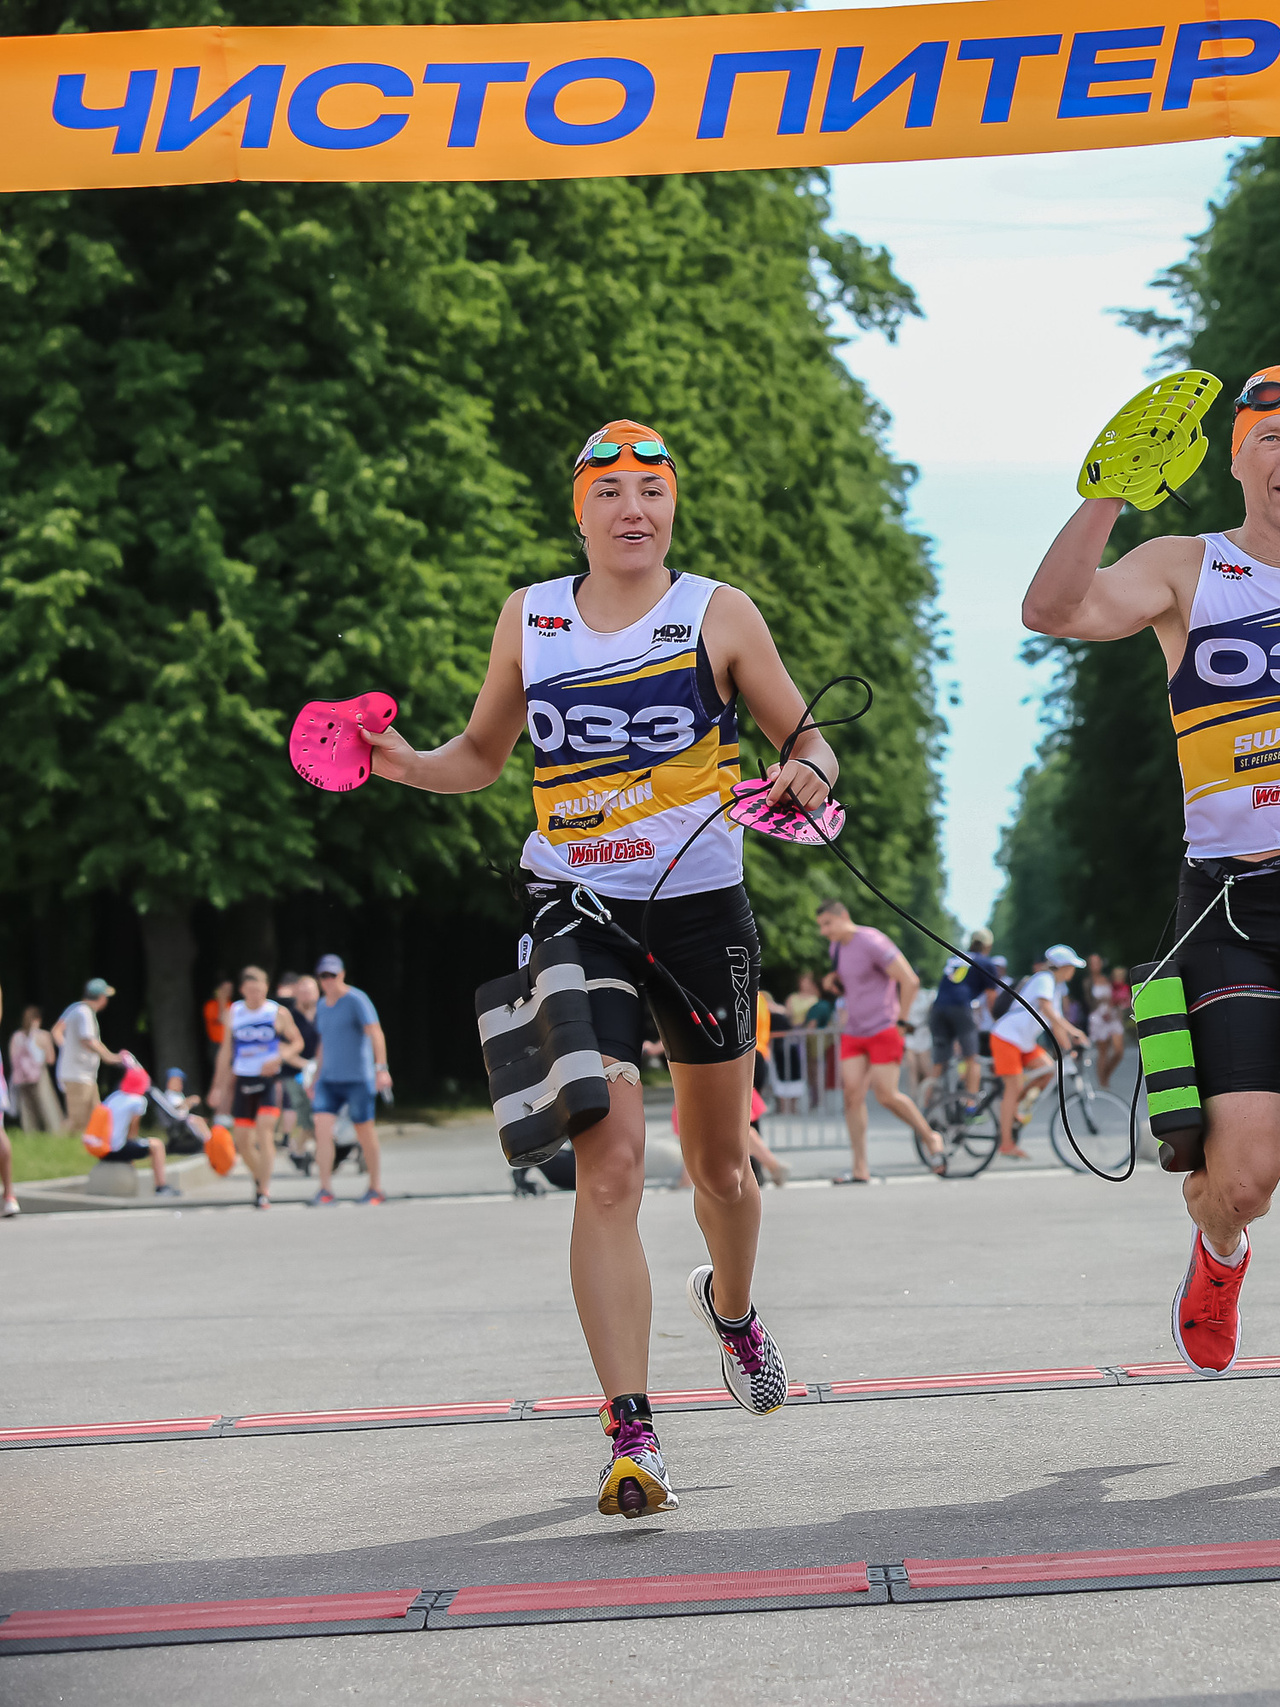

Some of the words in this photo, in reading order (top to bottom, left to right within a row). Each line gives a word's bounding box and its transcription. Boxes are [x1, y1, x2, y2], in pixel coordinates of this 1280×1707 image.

[52, 57, 655, 154] ЧИСТО
[527, 700, 695, 753] 033
[570, 842, 613, 865] World
[614, 840, 653, 860] Class
[725, 946, 753, 1044] 2XU
